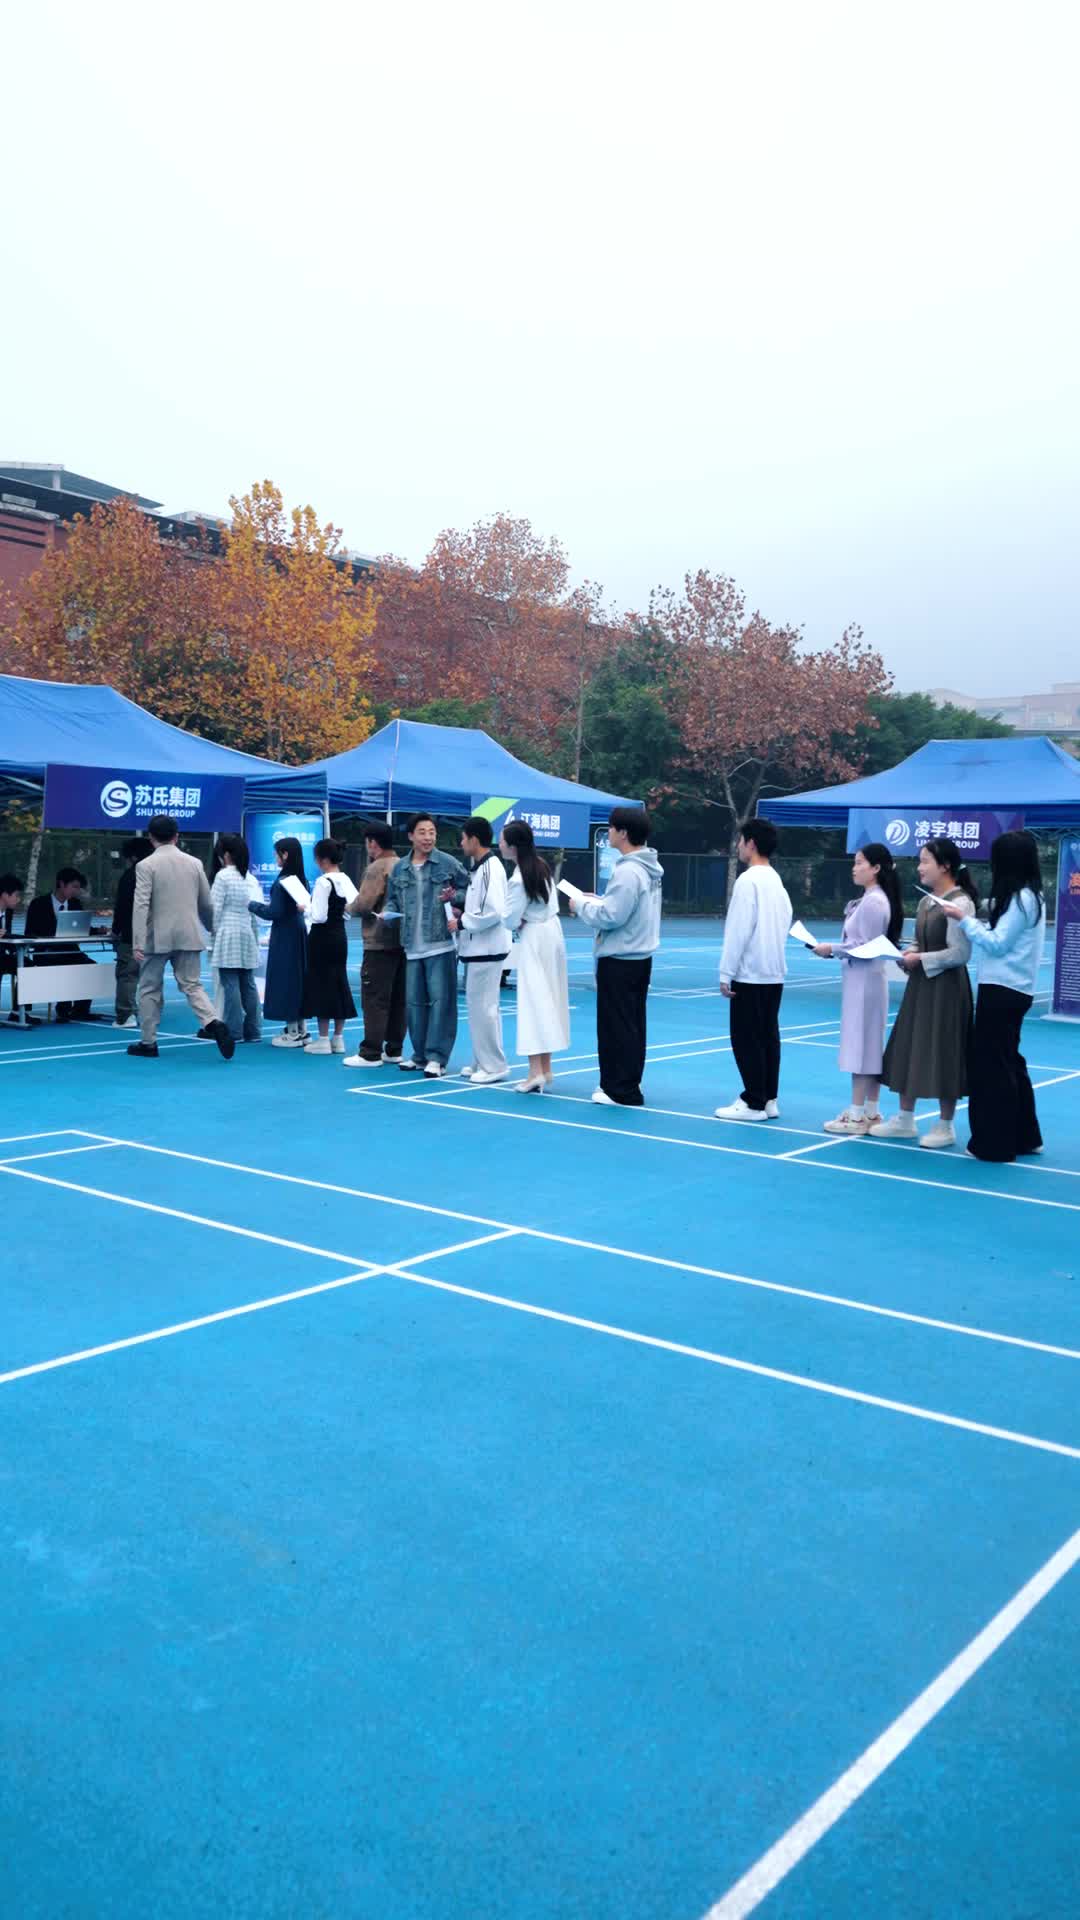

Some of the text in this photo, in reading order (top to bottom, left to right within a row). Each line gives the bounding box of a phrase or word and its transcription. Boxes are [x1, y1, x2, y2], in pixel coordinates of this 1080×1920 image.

[135, 785, 201, 808] 苏氏集团
[136, 808, 153, 816] SHU
[169, 809, 196, 818] GROUP
[914, 820, 980, 839] 凌宇集团
[952, 840, 980, 849] ROUP
